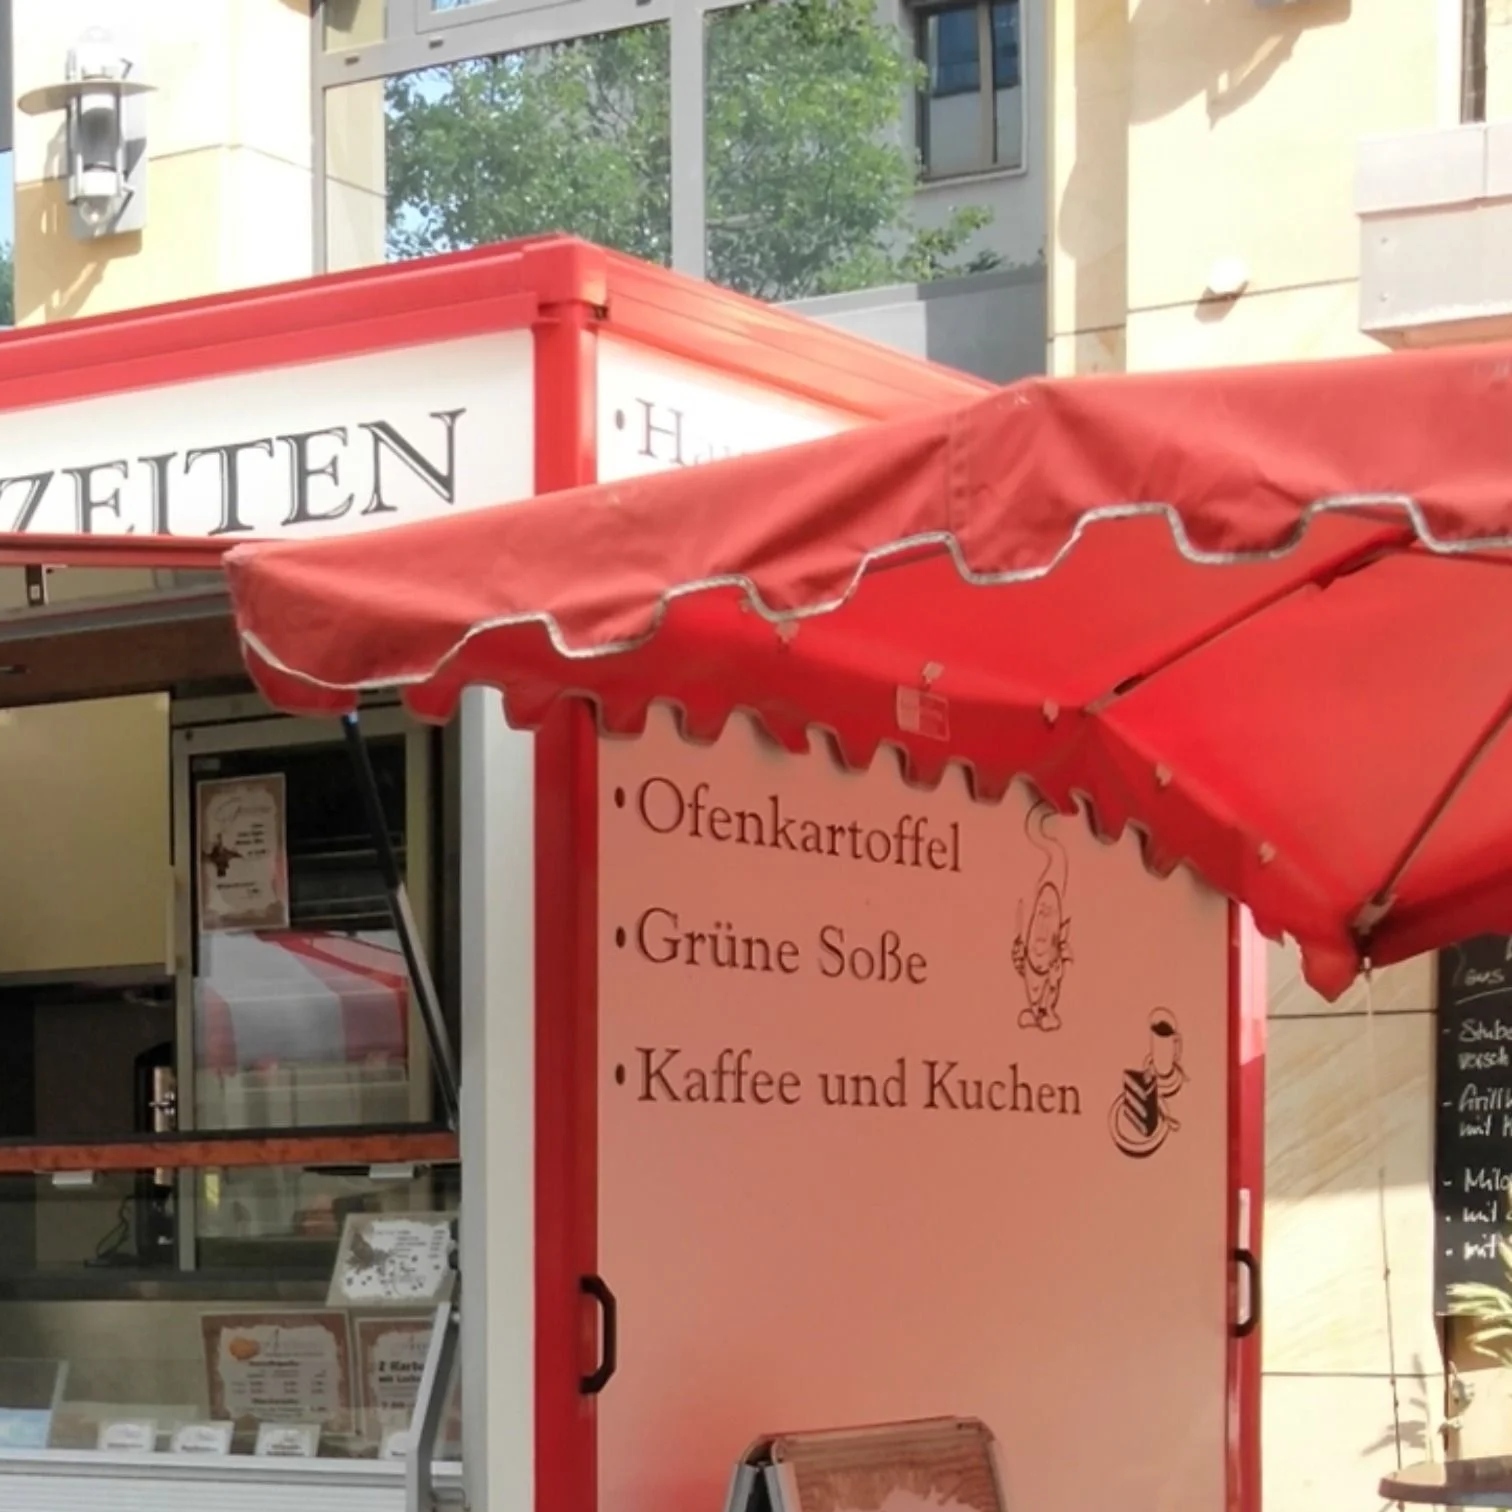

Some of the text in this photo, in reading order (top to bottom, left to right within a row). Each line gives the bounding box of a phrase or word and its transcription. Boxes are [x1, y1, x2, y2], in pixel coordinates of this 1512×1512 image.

[638, 777, 962, 873] Ofenkartoffel
[636, 907, 928, 984] Grüne Soße
[635, 1047, 1082, 1116] Kaffee und Kuchen
